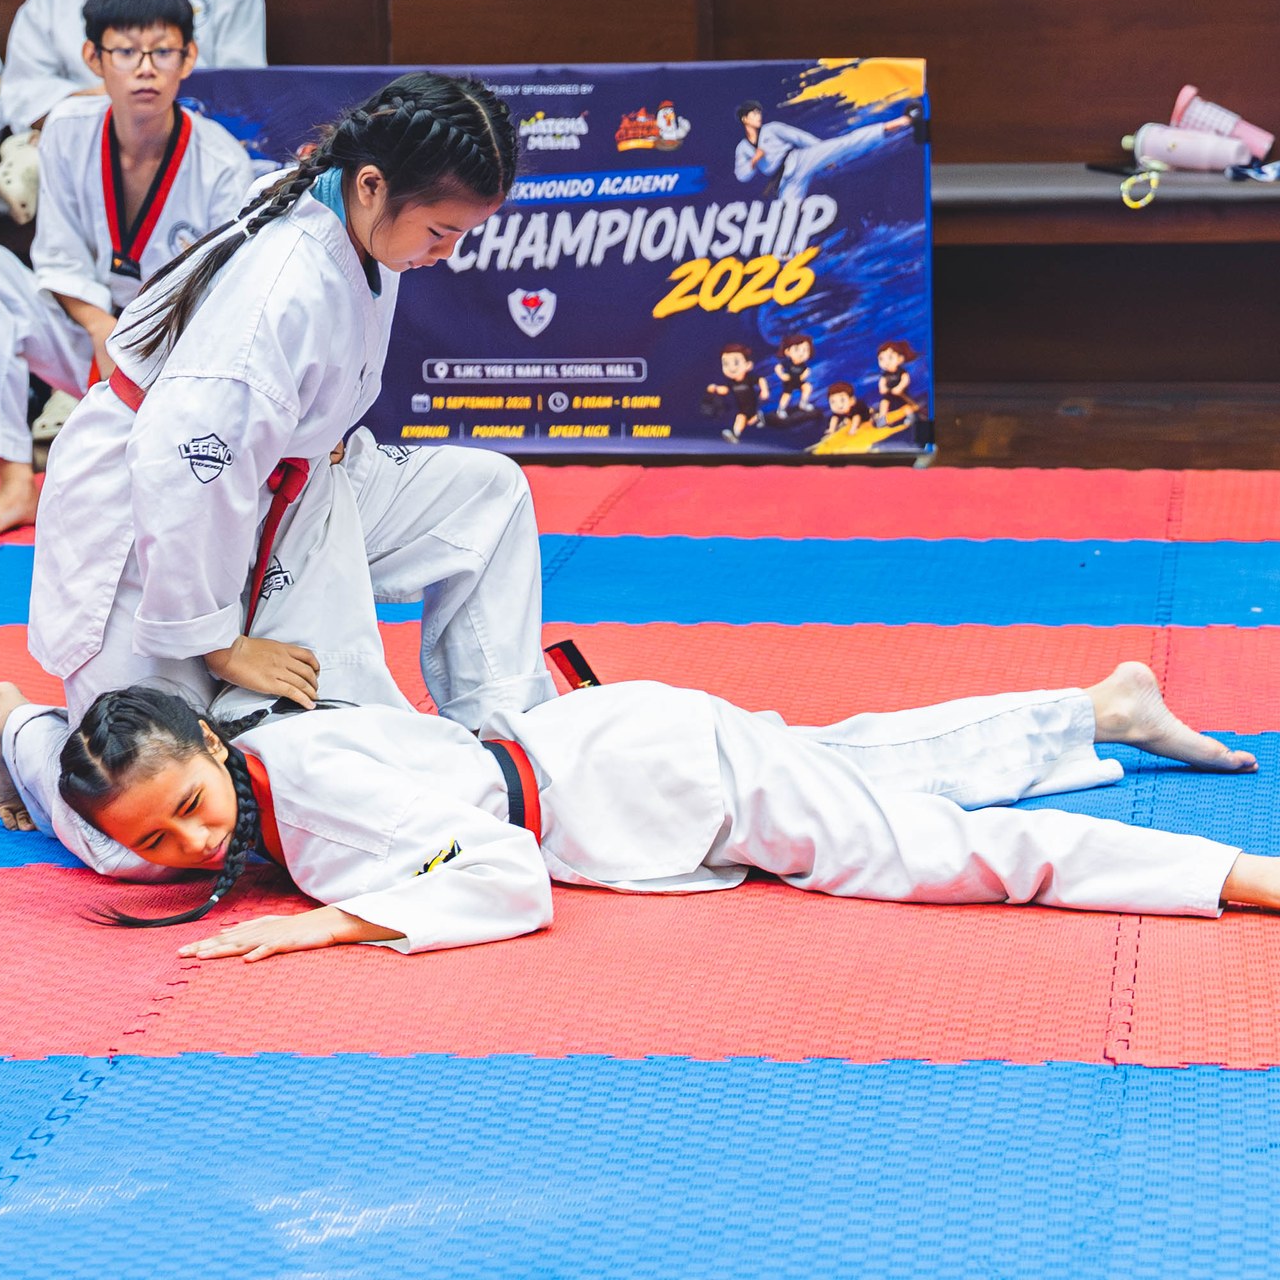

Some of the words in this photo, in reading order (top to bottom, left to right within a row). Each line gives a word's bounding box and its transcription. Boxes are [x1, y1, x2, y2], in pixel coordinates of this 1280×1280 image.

[581, 83, 595, 95] BY
[597, 173, 680, 195] ACADEMY
[446, 194, 838, 274] CHAMPIONSHIP
[651, 245, 821, 320] 2026
[484, 365, 514, 378] YOKE
[515, 365, 542, 378] NAM
[543, 364, 559, 378] KL
[560, 364, 604, 378] SCHOOL
[606, 364, 635, 377] HALL
[446, 396, 504, 409] SEPTEMBER
[548, 425, 582, 438] SPEED
[583, 425, 610, 438] KICK
[178, 441, 234, 466] LEGEND
